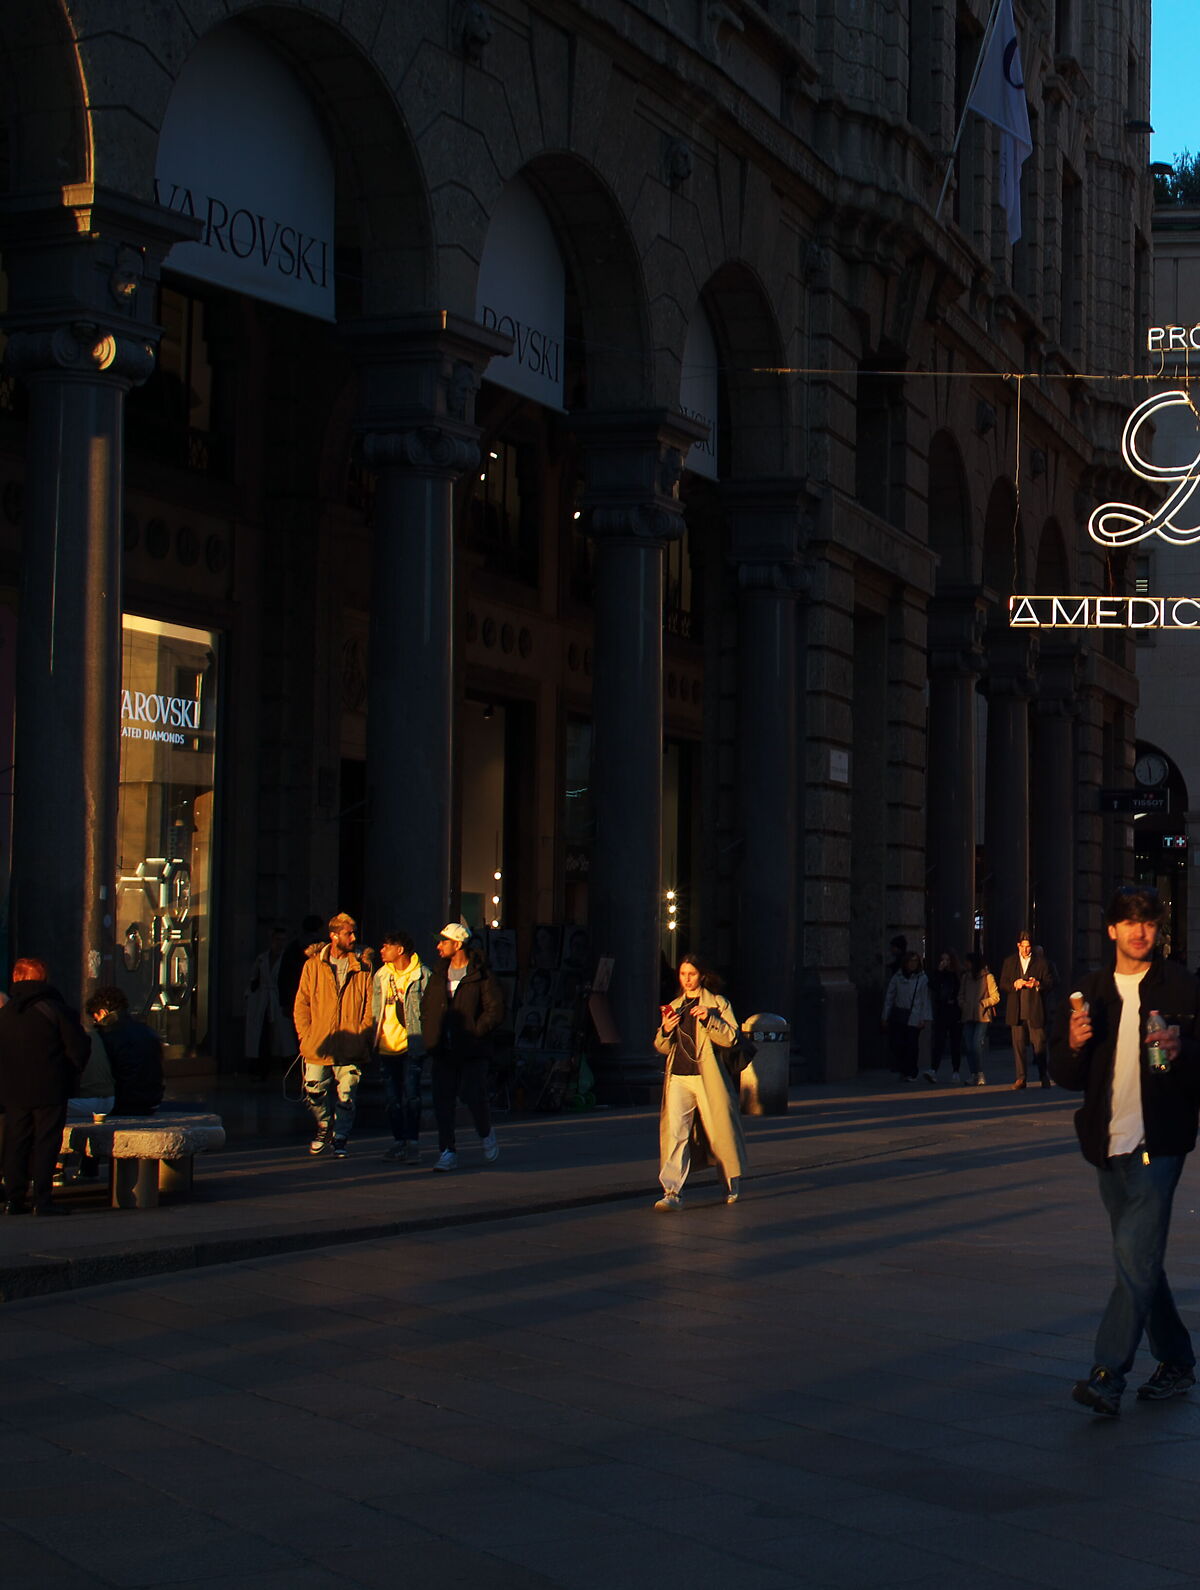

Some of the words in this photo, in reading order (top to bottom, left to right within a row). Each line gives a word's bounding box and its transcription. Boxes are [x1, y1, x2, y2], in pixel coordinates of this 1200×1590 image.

[1010, 597, 1040, 627] A
[121, 689, 200, 729] AROVSKI
[143, 729, 185, 744] DIAMONDS
